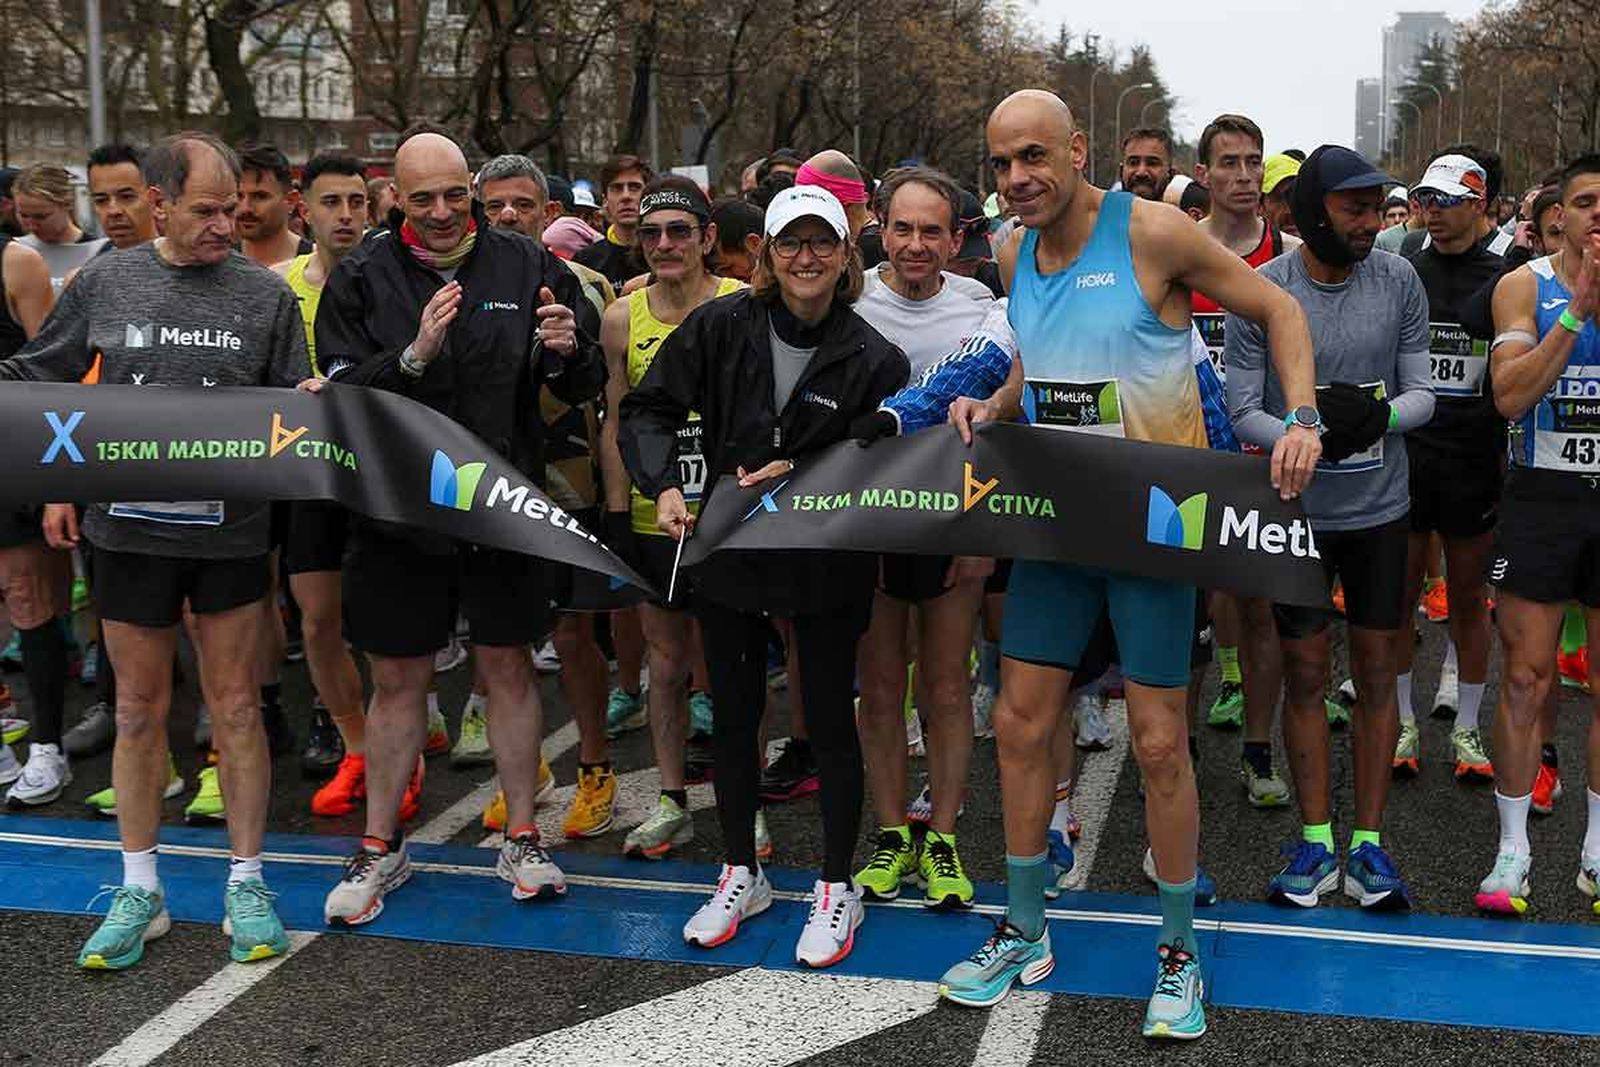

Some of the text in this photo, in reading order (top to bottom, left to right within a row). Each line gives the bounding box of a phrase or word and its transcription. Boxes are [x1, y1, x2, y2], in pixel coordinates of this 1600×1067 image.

[1077, 273, 1116, 288] HOKA
[160, 327, 242, 350] MetLife
[1054, 391, 1094, 403] MetLife
[41, 411, 86, 463] X
[96, 441, 159, 461] 15KM
[1561, 438, 1600, 465] 43
[792, 493, 851, 511] 15KM
